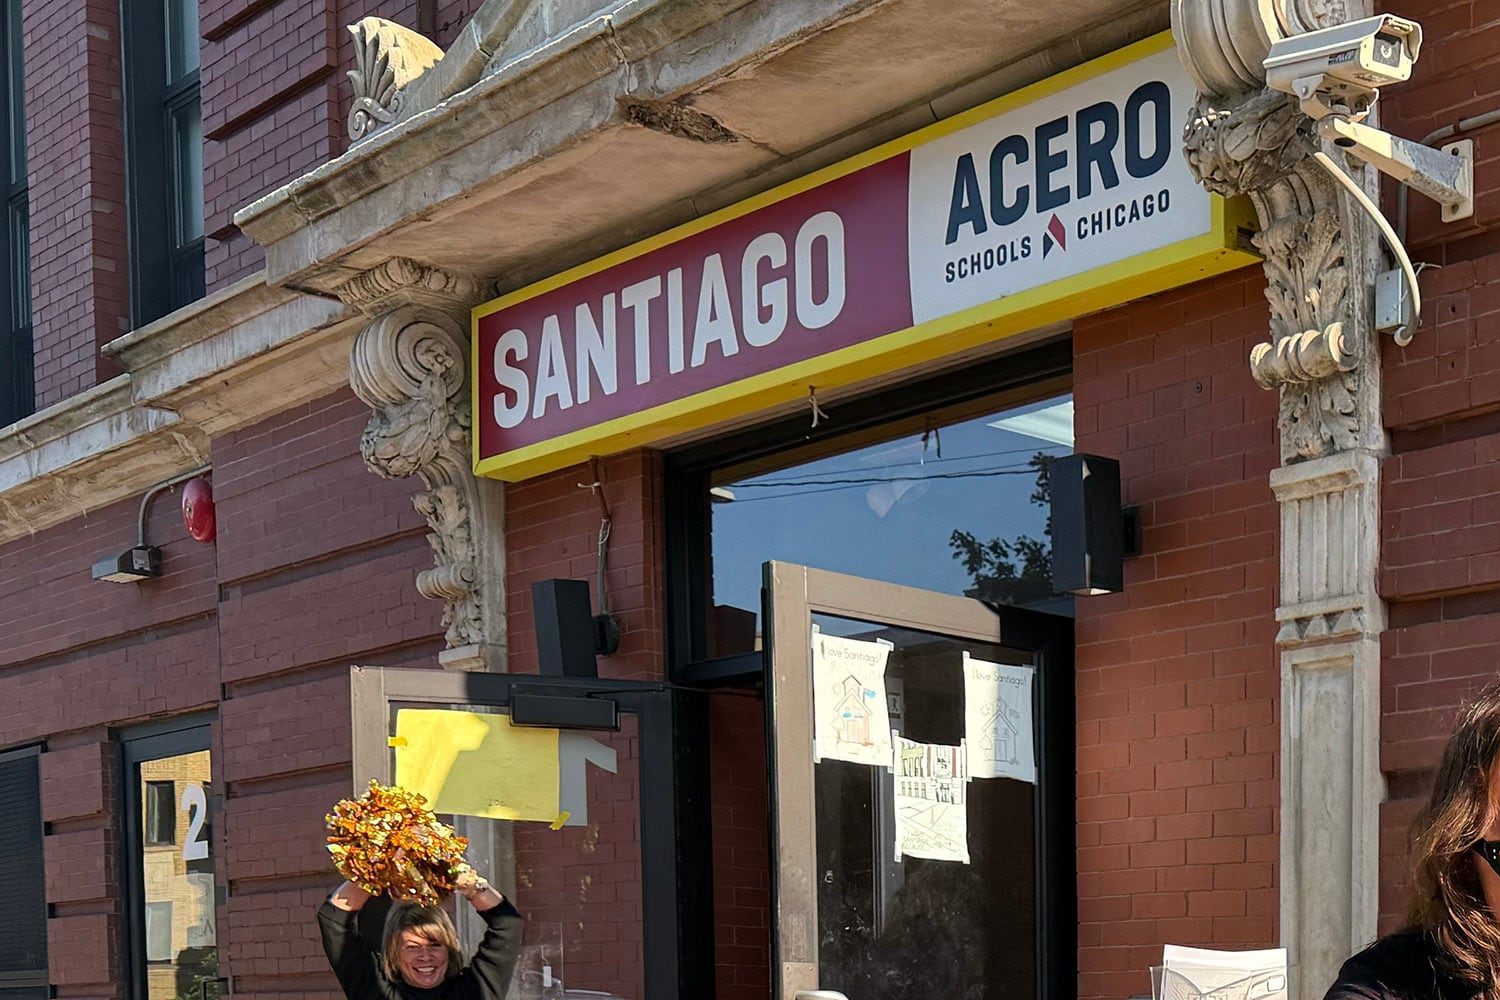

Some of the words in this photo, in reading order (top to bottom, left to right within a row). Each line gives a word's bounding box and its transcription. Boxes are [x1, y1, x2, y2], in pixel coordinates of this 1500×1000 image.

[945, 80, 1171, 246] ACERO
[945, 236, 1032, 283] SCHOOLS
[1077, 188, 1170, 240] CHICAGO
[493, 210, 846, 430] SANTIAGO
[181, 784, 209, 861] 2
